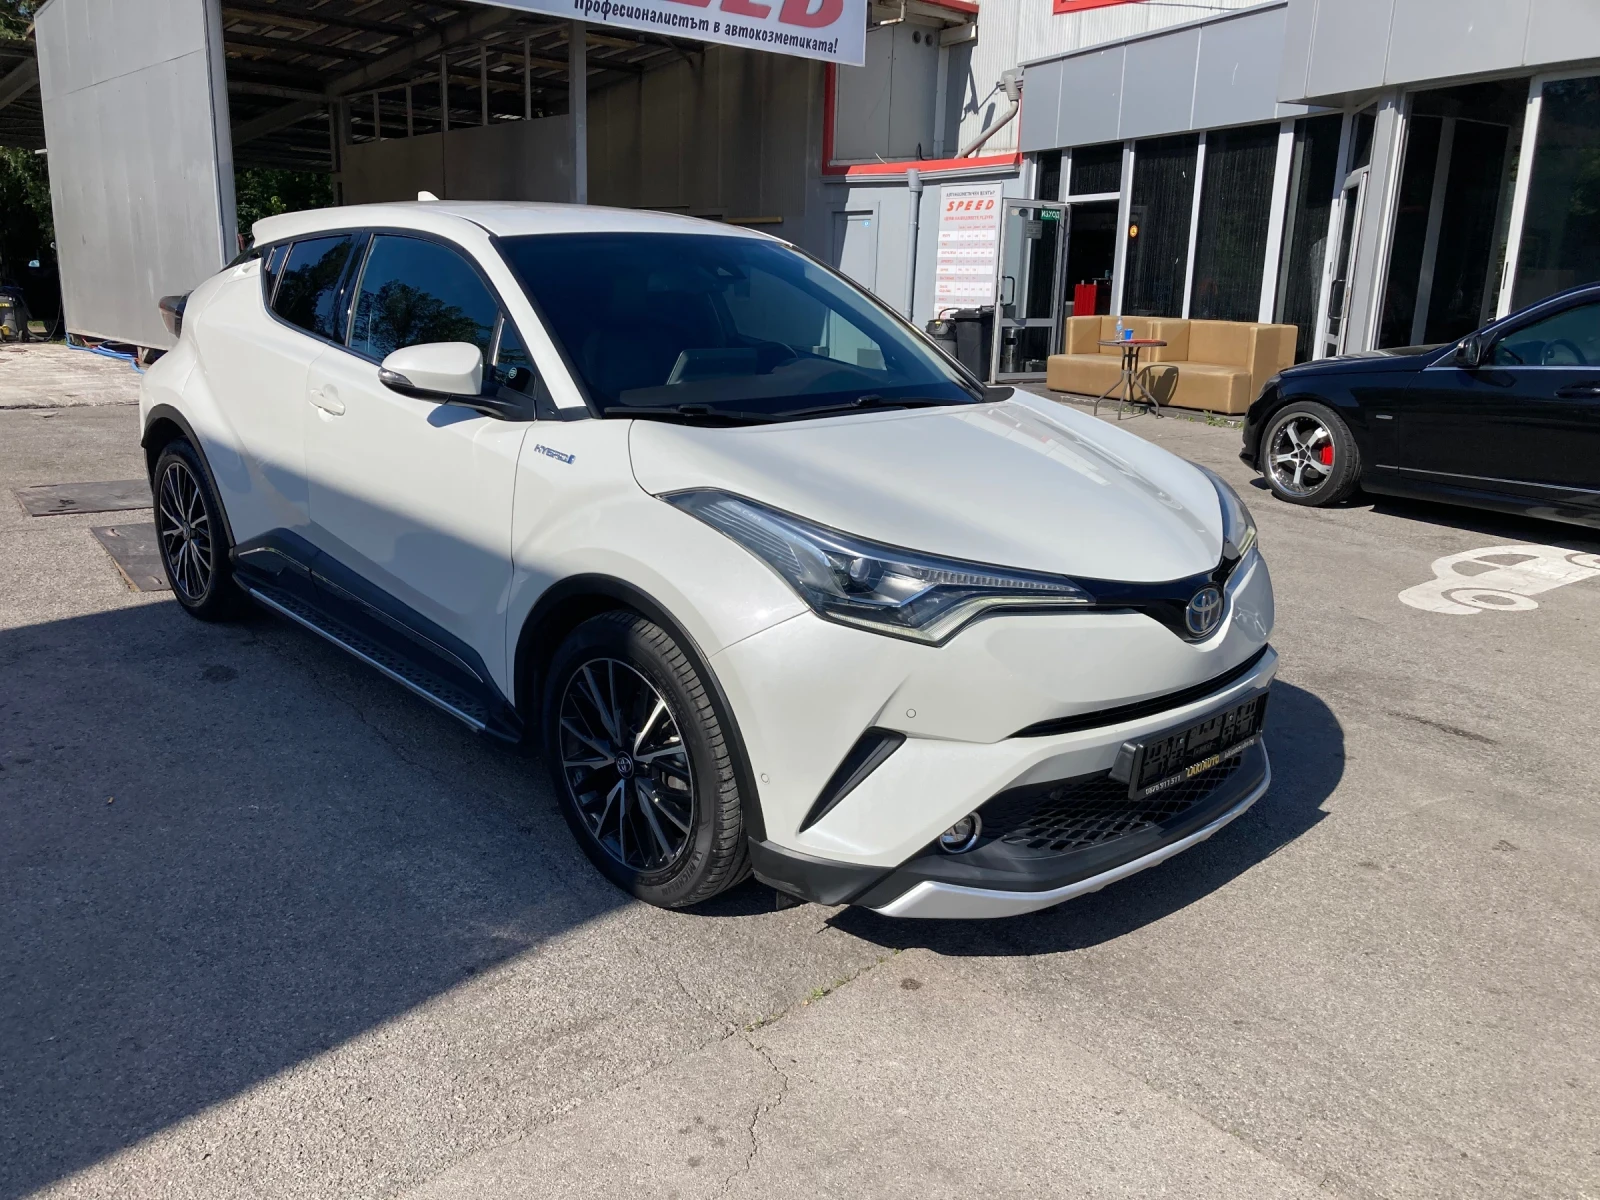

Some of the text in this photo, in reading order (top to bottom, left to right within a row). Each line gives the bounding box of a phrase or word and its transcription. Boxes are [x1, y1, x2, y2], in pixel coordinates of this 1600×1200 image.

[713, 21, 721, 33] в
[724, 23, 839, 54] автокозметиката!
[946, 199, 995, 212] SPEED
[1041, 209, 1060, 219] ИЗХОД
[534, 444, 576, 465] HYBRID
[661, 861, 697, 896] MICHELIN
